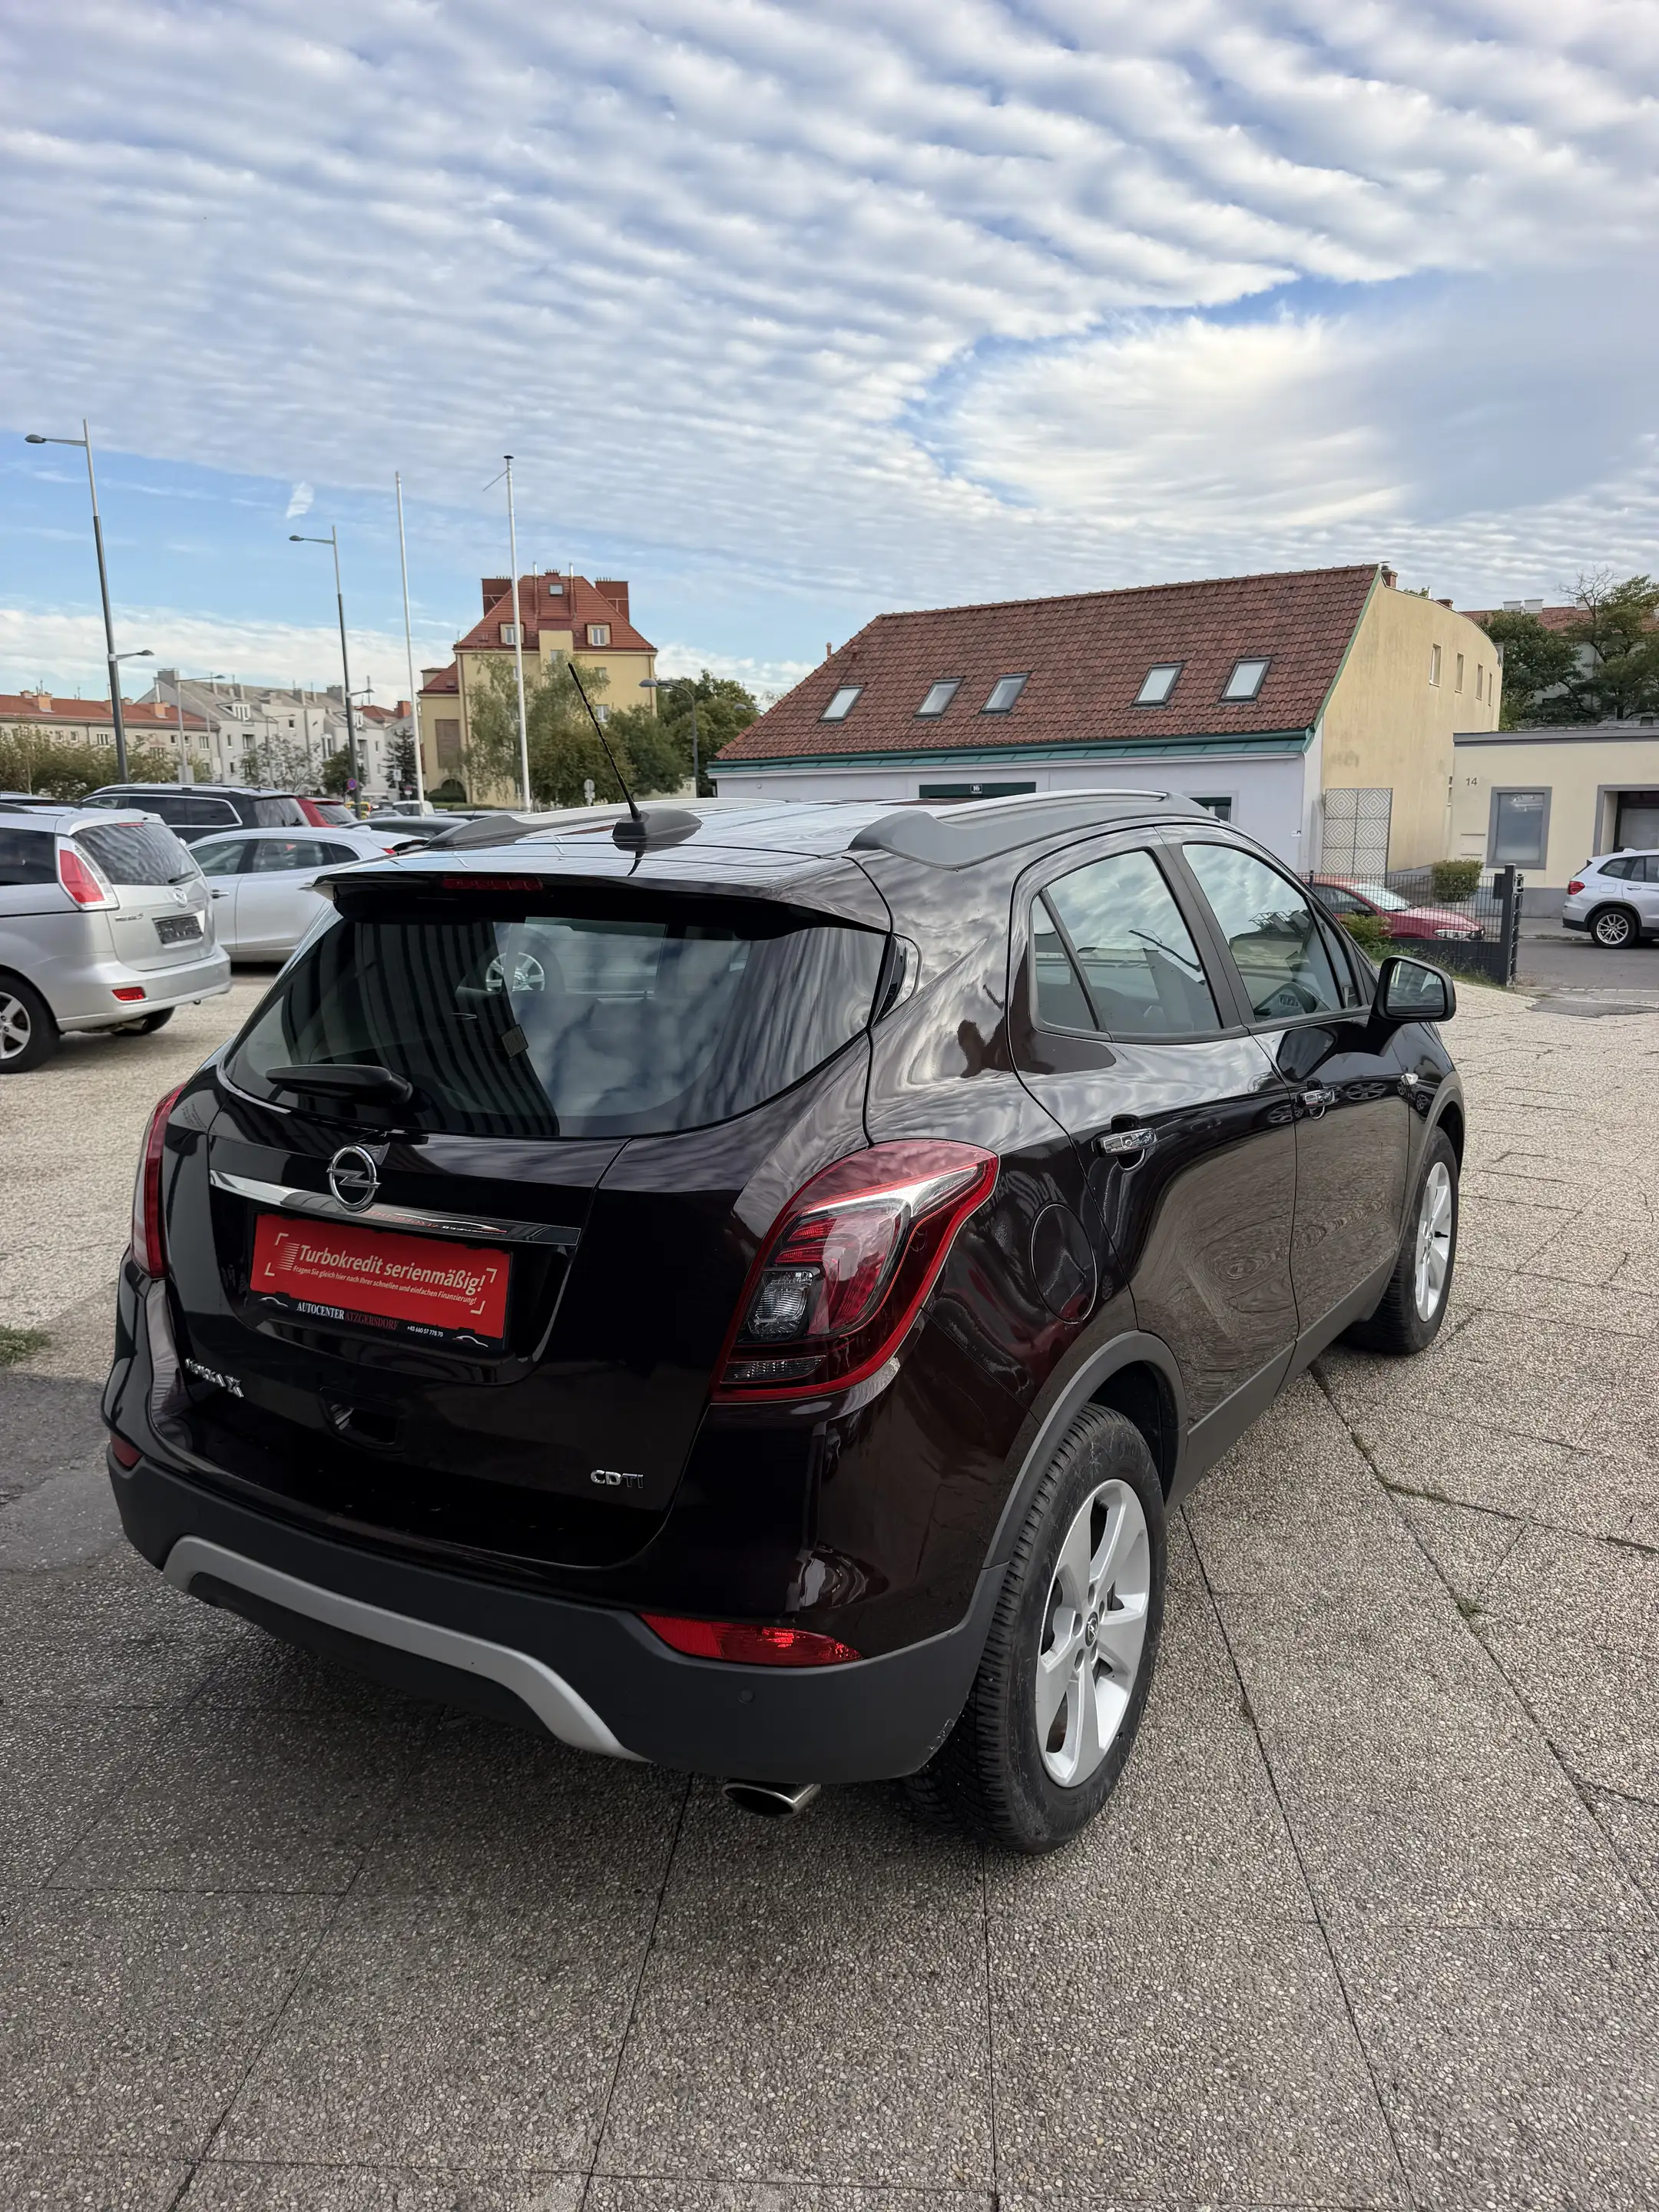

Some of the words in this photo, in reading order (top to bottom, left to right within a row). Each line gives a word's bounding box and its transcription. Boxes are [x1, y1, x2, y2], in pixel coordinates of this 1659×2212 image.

[1465, 777, 1478, 786] 14
[299, 1245, 383, 1275] Turbokredit
[383, 1263, 486, 1296] serienmäßig!
[293, 1265, 311, 1275] Fragen
[319, 1270, 336, 1278] gleich
[335, 1272, 347, 1280] hier
[346, 1274, 359, 1283] nach
[359, 1277, 373, 1286] Ihrer
[373, 1279, 399, 1290] schnellen
[410, 1286, 438, 1297] einfachen
[438, 1290, 477, 1306] Finanzierung!
[296, 1302, 345, 1320] AUTOCENTER
[590, 1469, 644, 1488] CDTI
